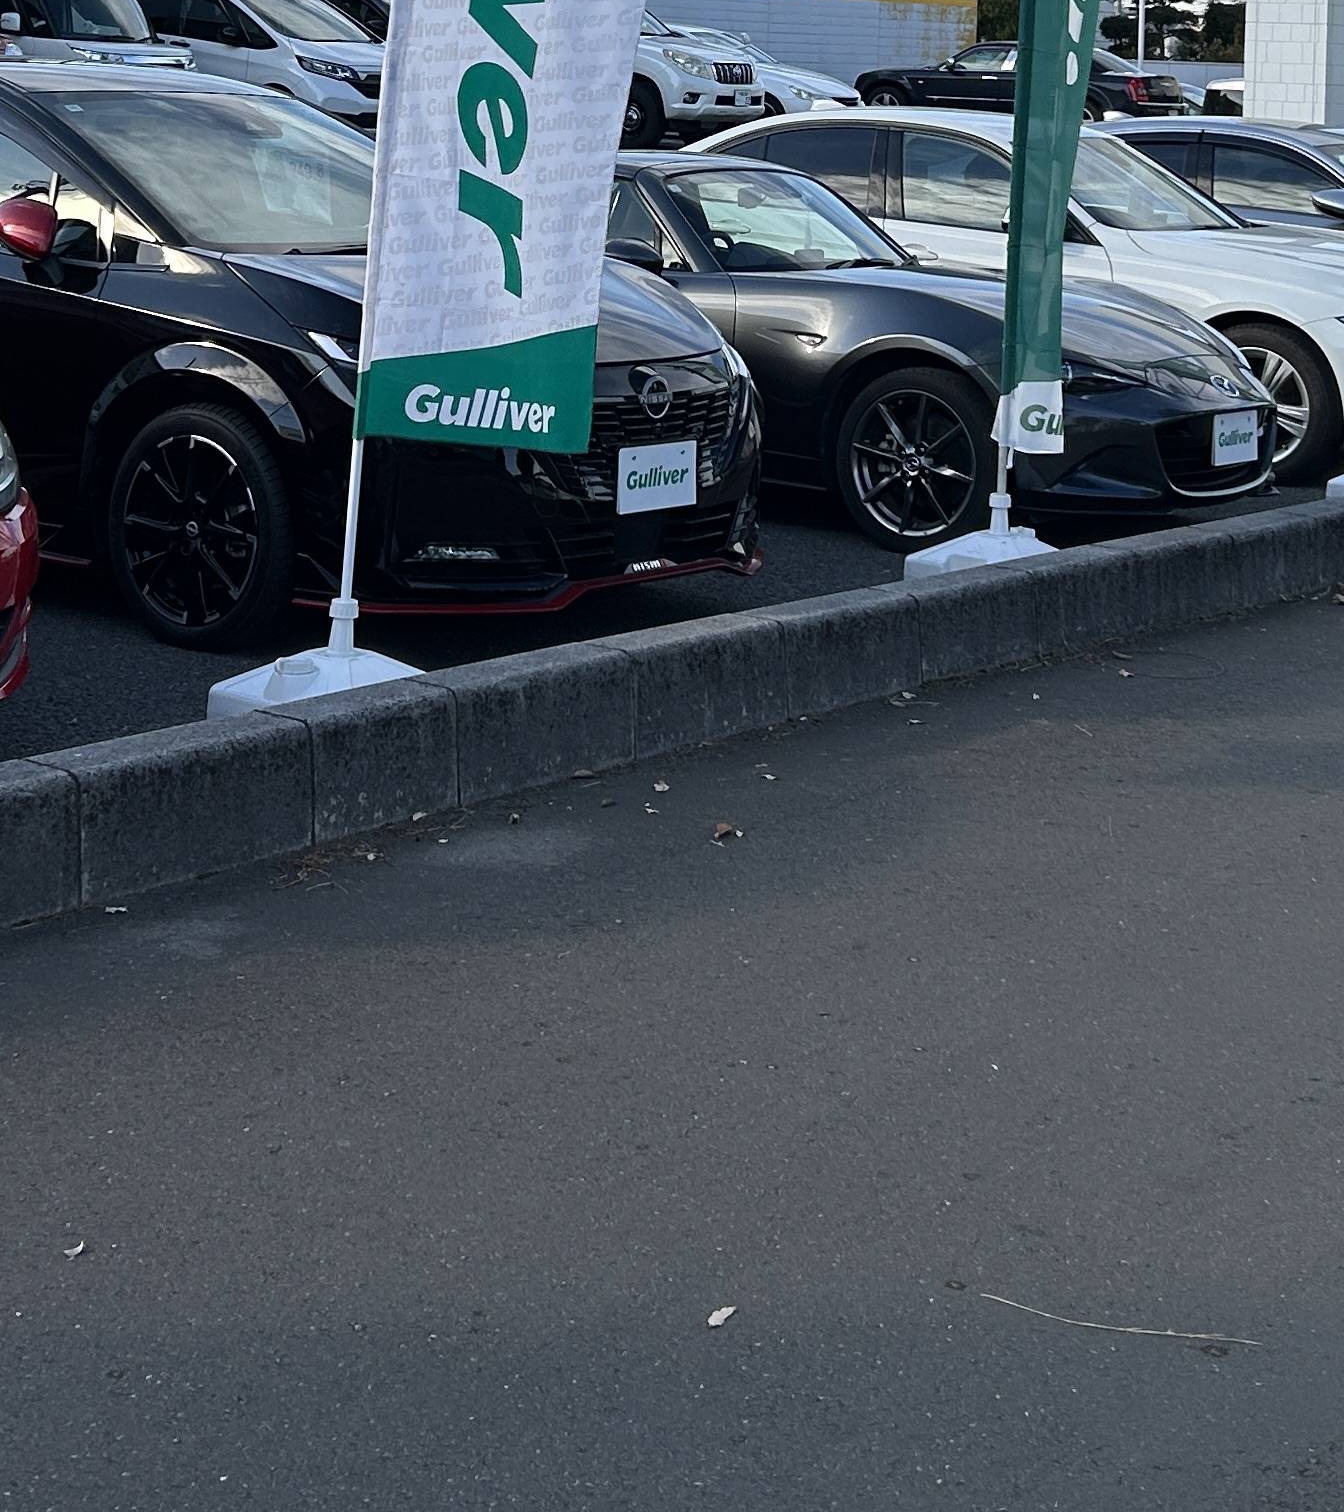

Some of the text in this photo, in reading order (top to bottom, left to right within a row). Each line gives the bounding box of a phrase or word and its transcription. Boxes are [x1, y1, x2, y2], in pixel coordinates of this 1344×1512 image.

[404, 383, 556, 434] Gulliver
[1218, 428, 1255, 448] Gulliver
[626, 463, 690, 491] Gulliver
